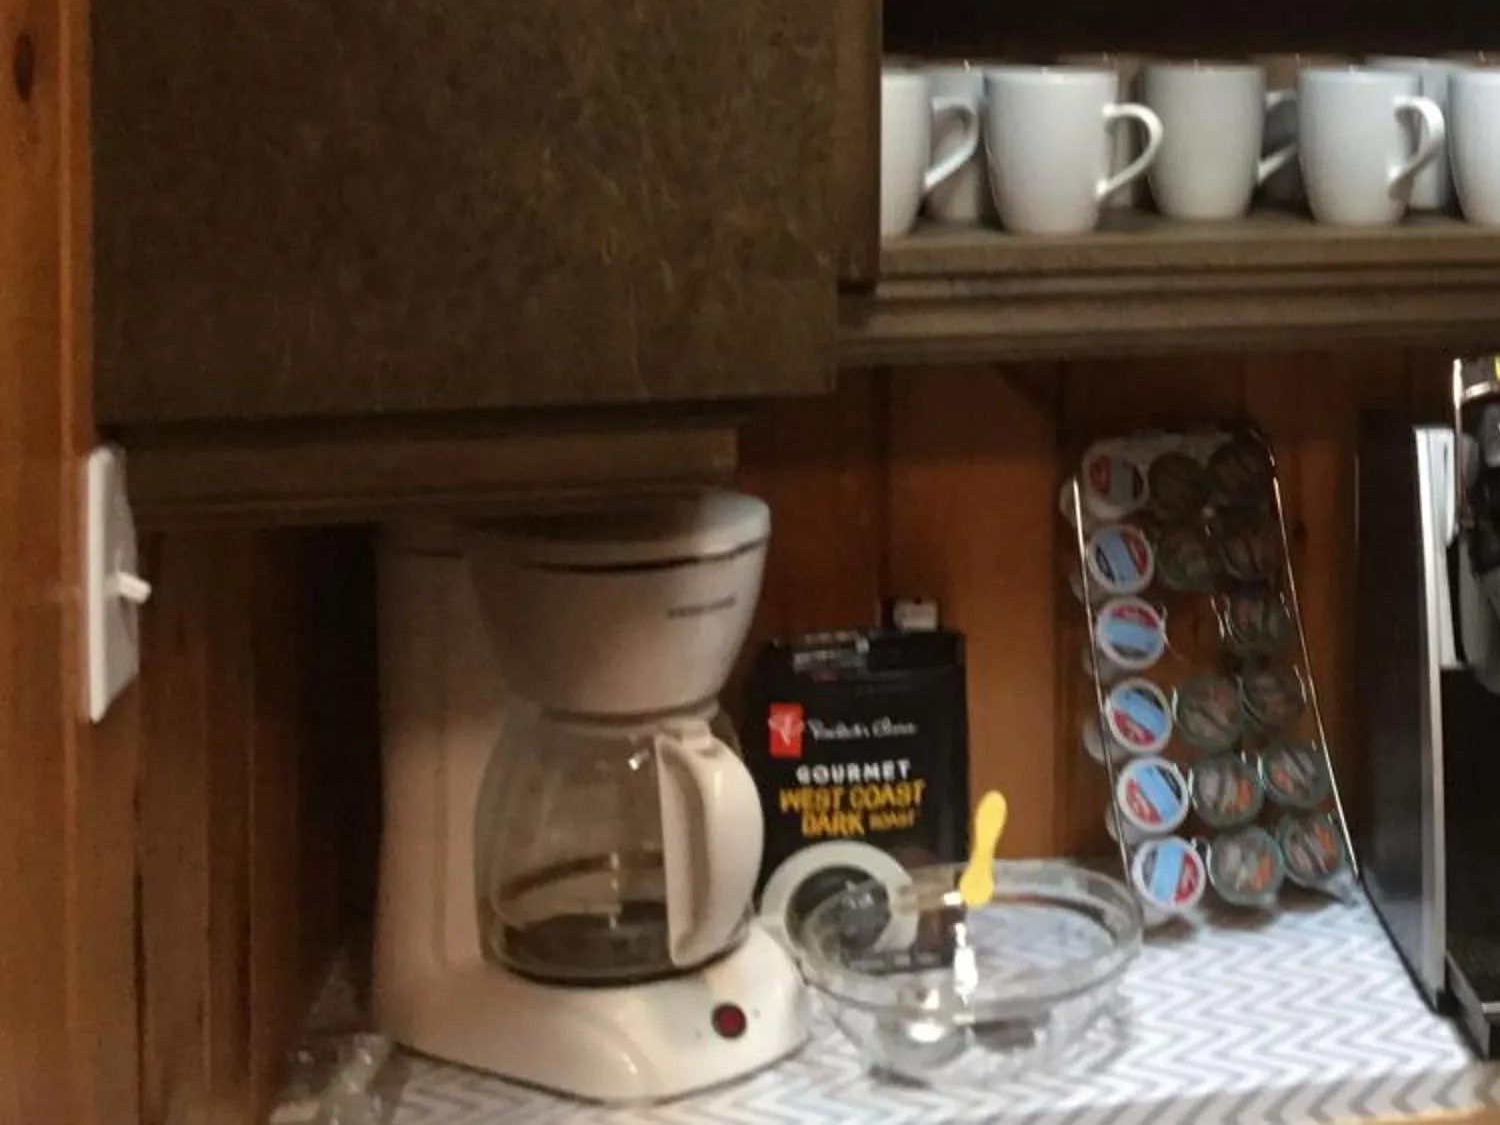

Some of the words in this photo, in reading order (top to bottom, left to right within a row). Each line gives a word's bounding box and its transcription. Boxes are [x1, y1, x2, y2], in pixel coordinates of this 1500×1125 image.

[796, 759, 910, 784] GOURMET
[780, 786, 844, 813] WEST
[850, 779, 926, 811] COAST
[802, 810, 865, 836] DARK
